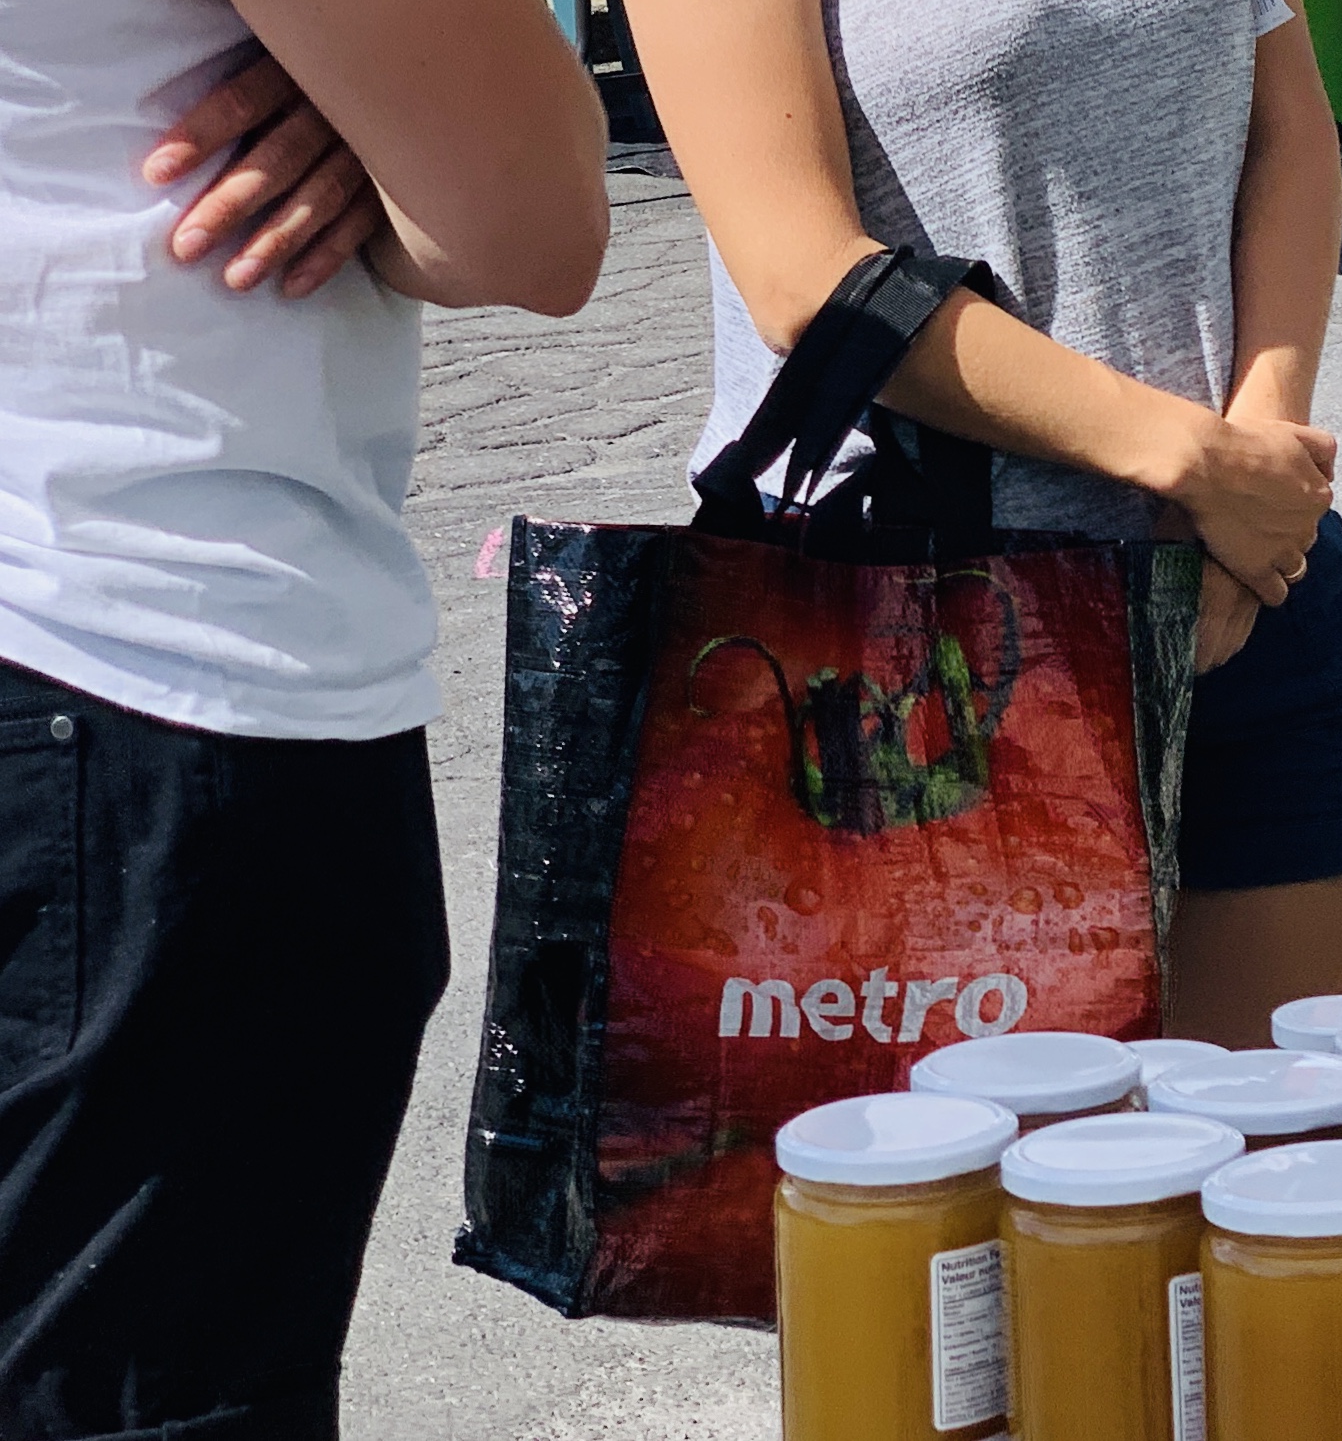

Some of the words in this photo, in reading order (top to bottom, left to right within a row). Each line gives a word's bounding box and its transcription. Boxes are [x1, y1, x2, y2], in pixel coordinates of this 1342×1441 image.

[718, 965, 1028, 1043] metro
[940, 1253, 986, 1273] Nutrition
[941, 1269, 976, 1285] Valeur
